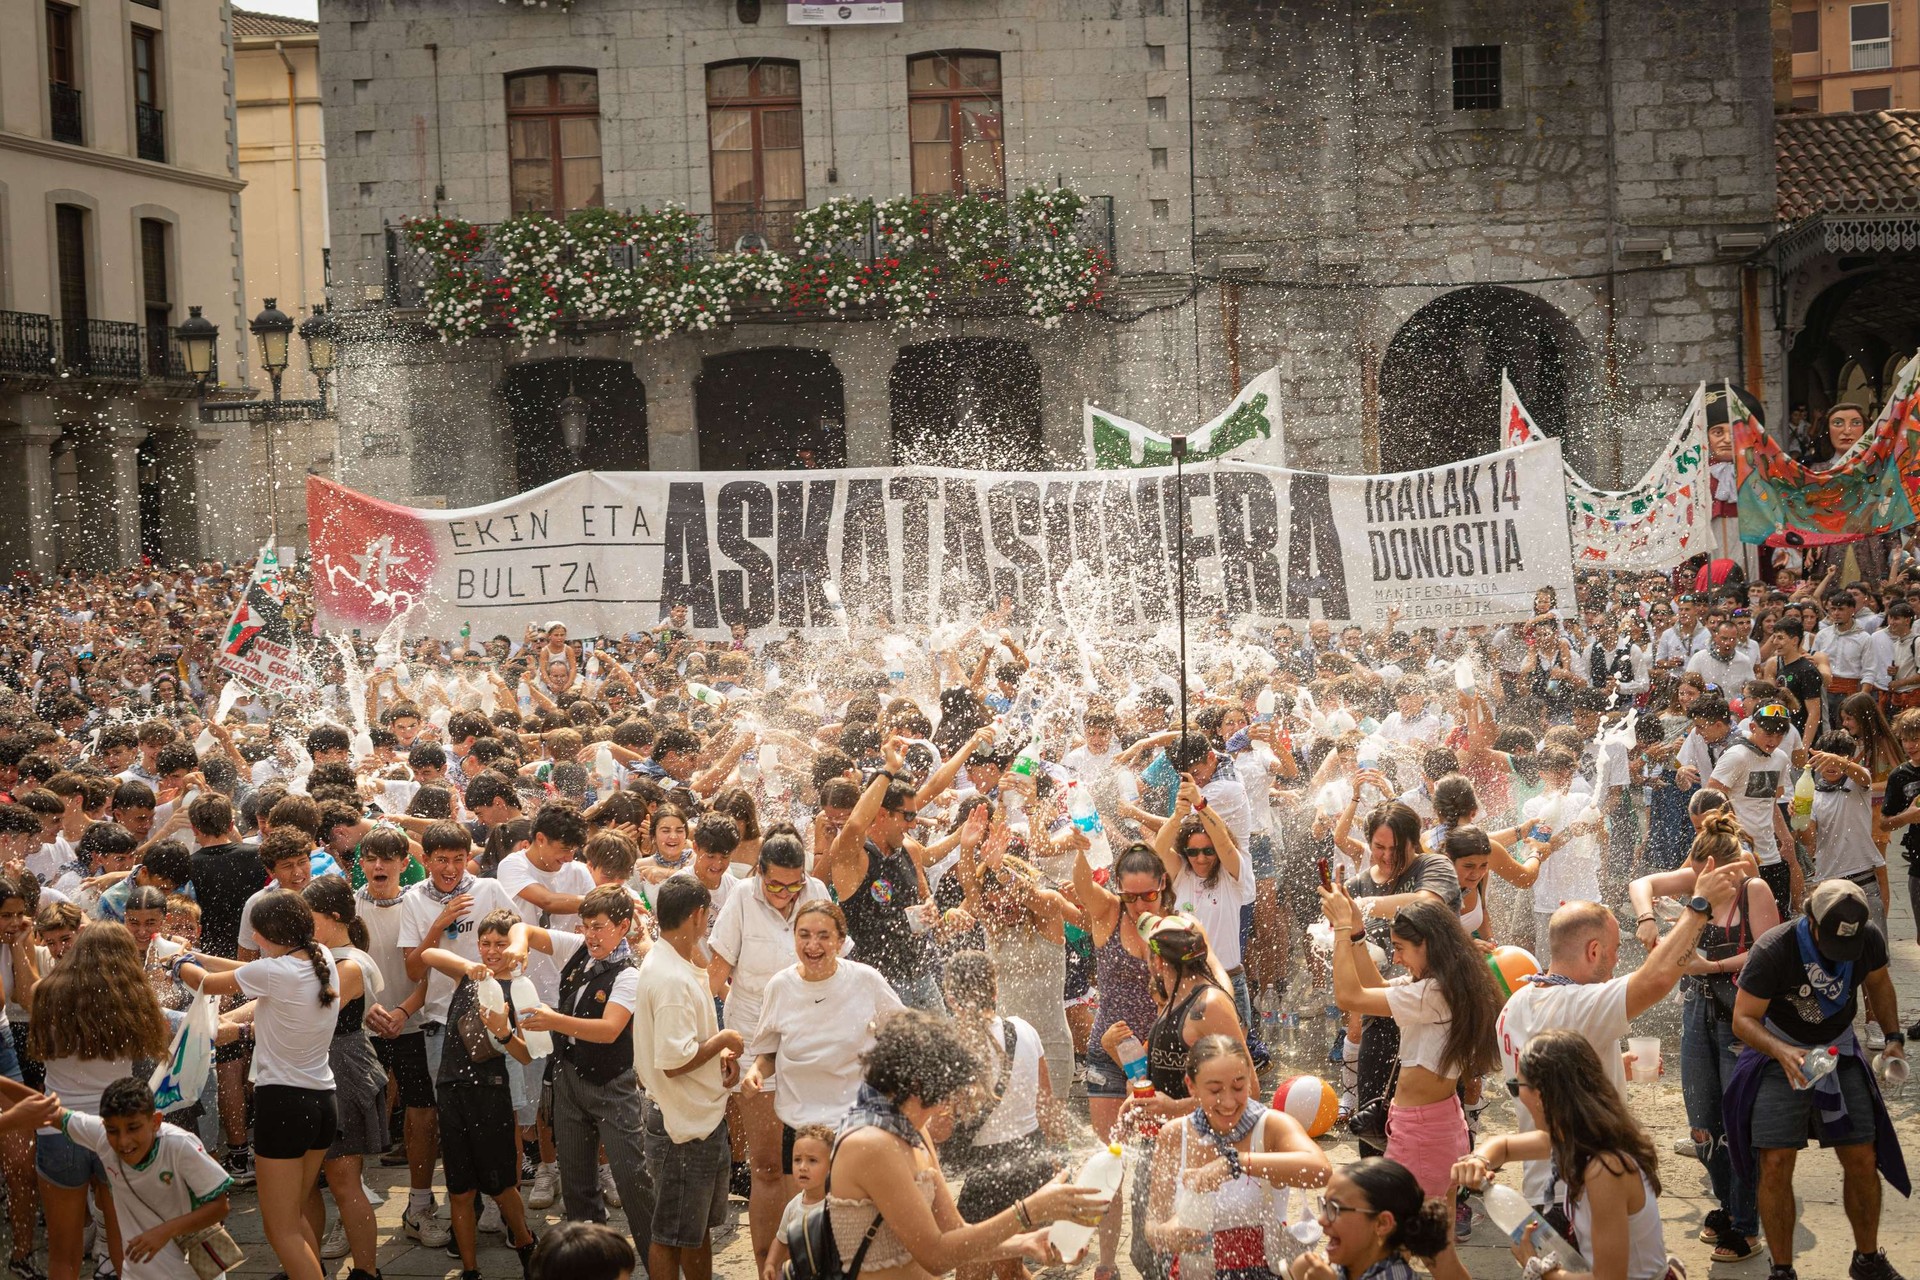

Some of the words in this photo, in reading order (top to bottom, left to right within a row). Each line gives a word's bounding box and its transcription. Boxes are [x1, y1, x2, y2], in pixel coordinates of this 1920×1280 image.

[1364, 464, 1482, 524] IRAILAK
[1488, 458, 1521, 512] 14
[449, 509, 549, 547] EKIN
[583, 504, 652, 538] ETA
[1367, 518, 1525, 582] DONOSTIA
[457, 561, 600, 599] BULTZA
[1375, 582, 1500, 600] MANIFESTAZIOA
